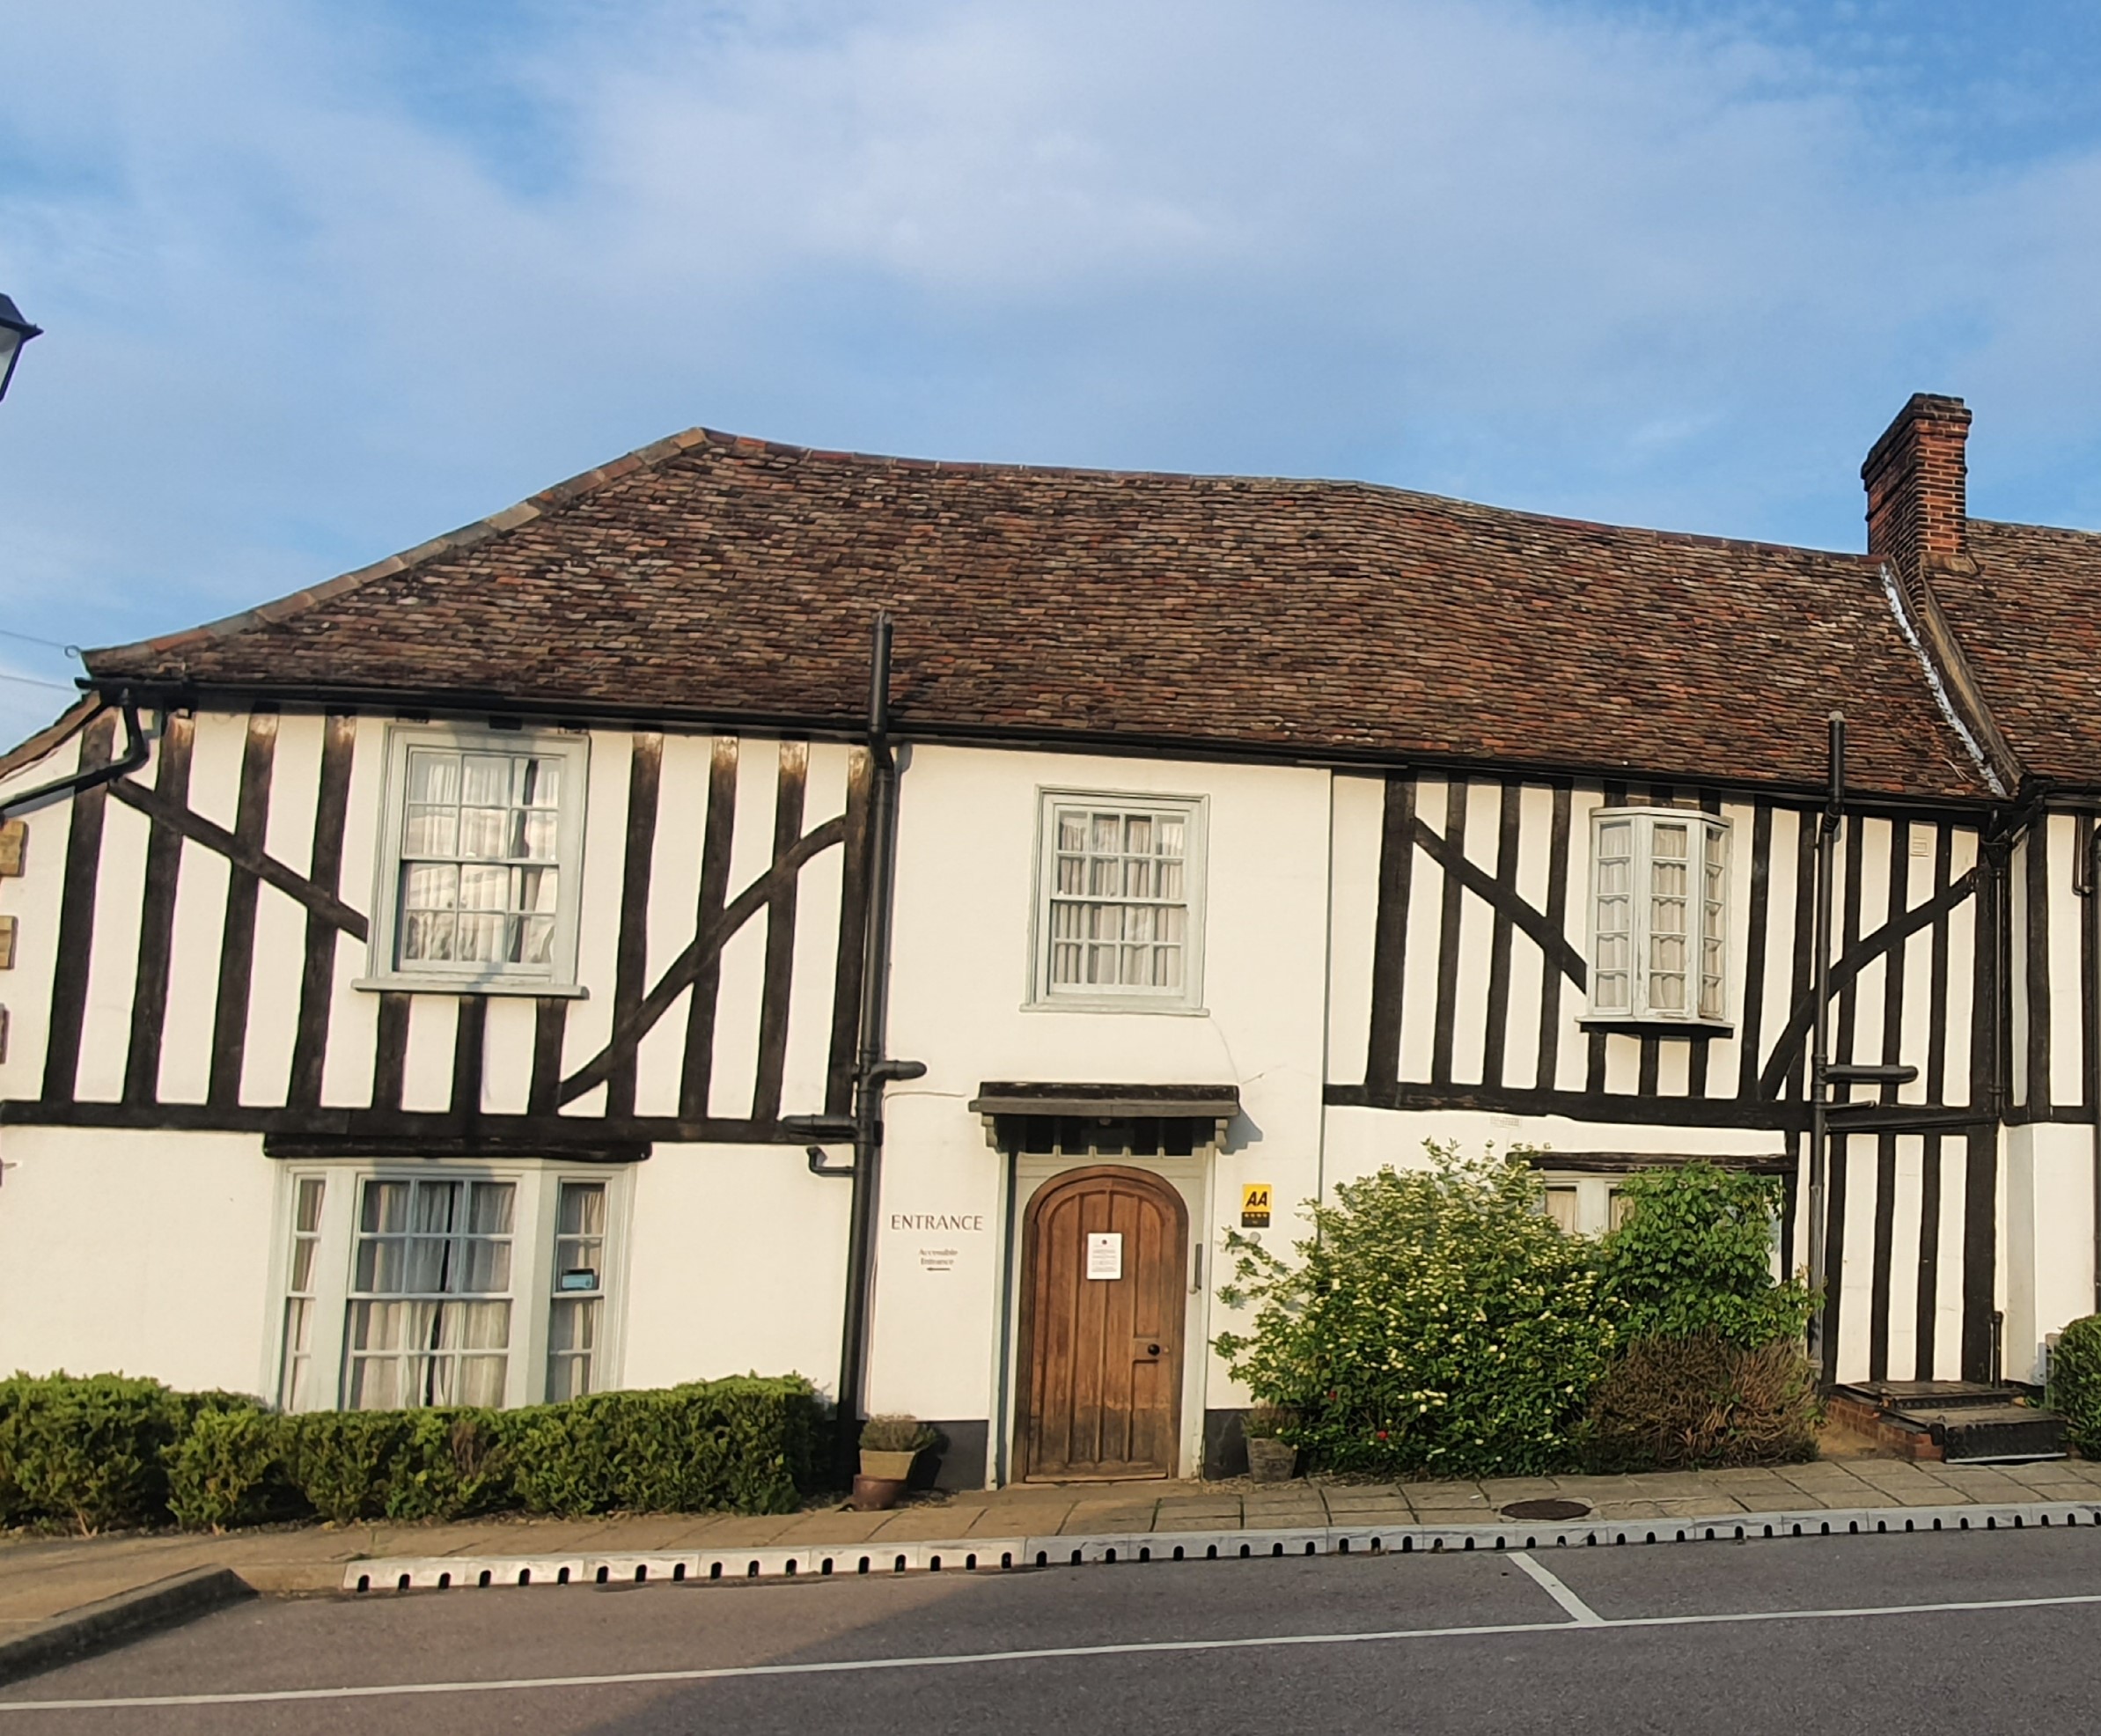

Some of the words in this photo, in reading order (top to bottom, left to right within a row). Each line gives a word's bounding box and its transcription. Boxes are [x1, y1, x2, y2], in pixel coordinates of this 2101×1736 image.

[1245, 1190, 1267, 1208] AA
[892, 1214, 983, 1231] ENTRANCE
[921, 1257, 954, 1266] Entrance
